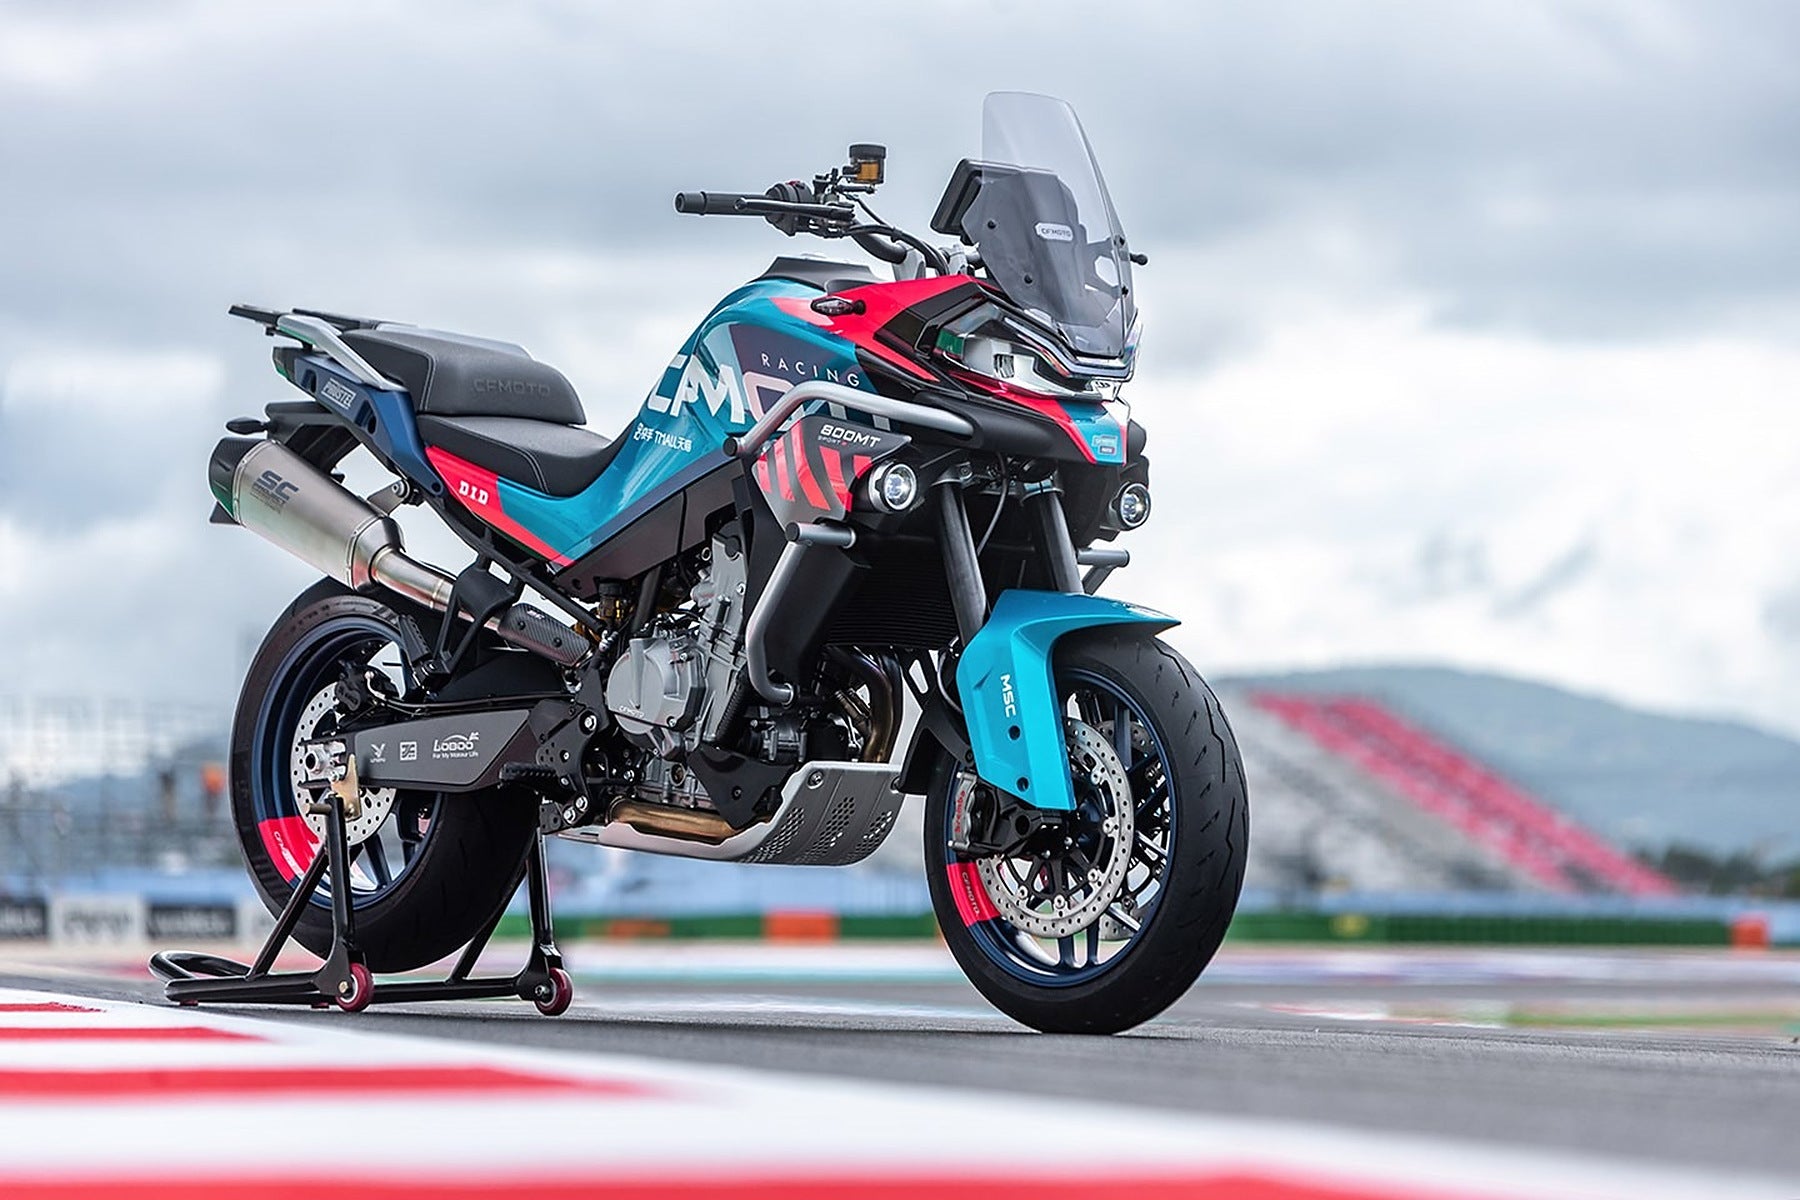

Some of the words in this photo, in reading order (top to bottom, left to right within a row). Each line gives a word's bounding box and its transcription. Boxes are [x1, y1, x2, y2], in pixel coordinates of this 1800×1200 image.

[761, 353, 860, 388] RACING
[473, 379, 551, 397] CFMOTO
[820, 424, 881, 448] 800MT
[256, 469, 299, 501] SC
[1000, 674, 1017, 718] MSC
